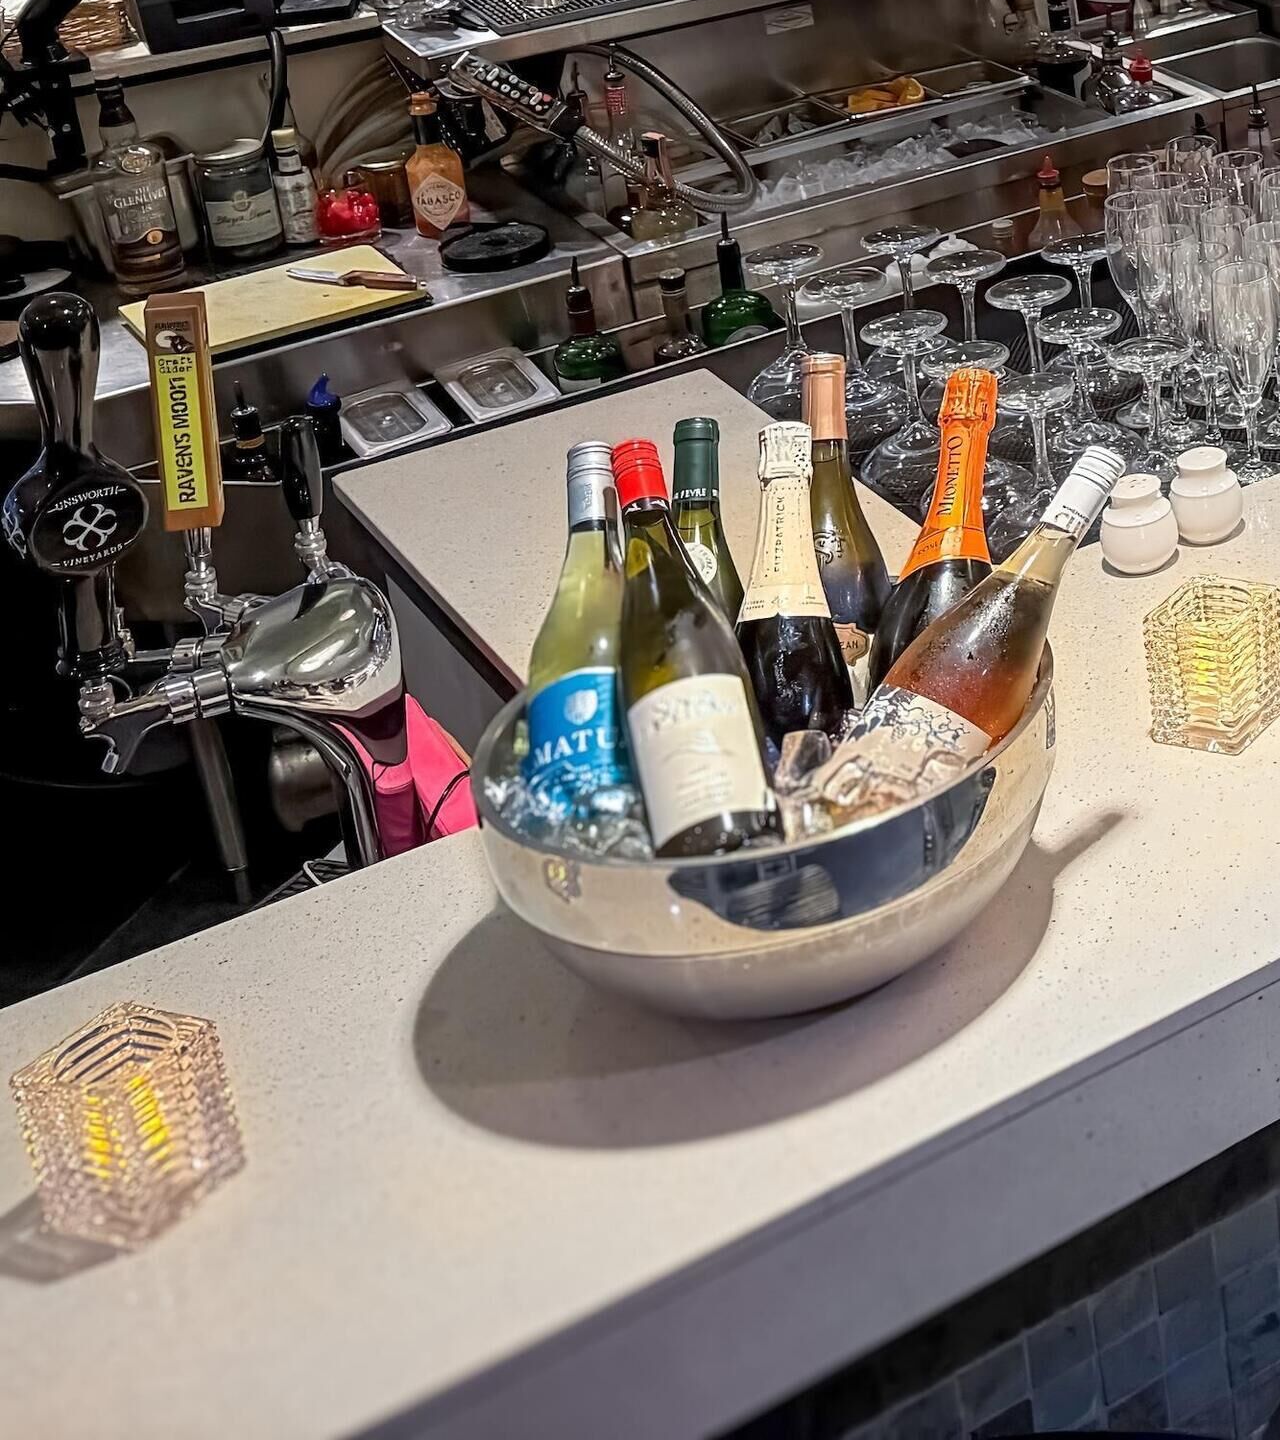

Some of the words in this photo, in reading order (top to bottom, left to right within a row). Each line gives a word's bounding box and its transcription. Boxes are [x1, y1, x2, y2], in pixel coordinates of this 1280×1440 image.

[416, 191, 461, 206] TABASCO
[158, 356, 193, 367] Craft
[55, 485, 119, 511] UNSWORTH
[774, 496, 786, 573] FITZPATRICK
[63, 543, 123, 568] VINEYARDS
